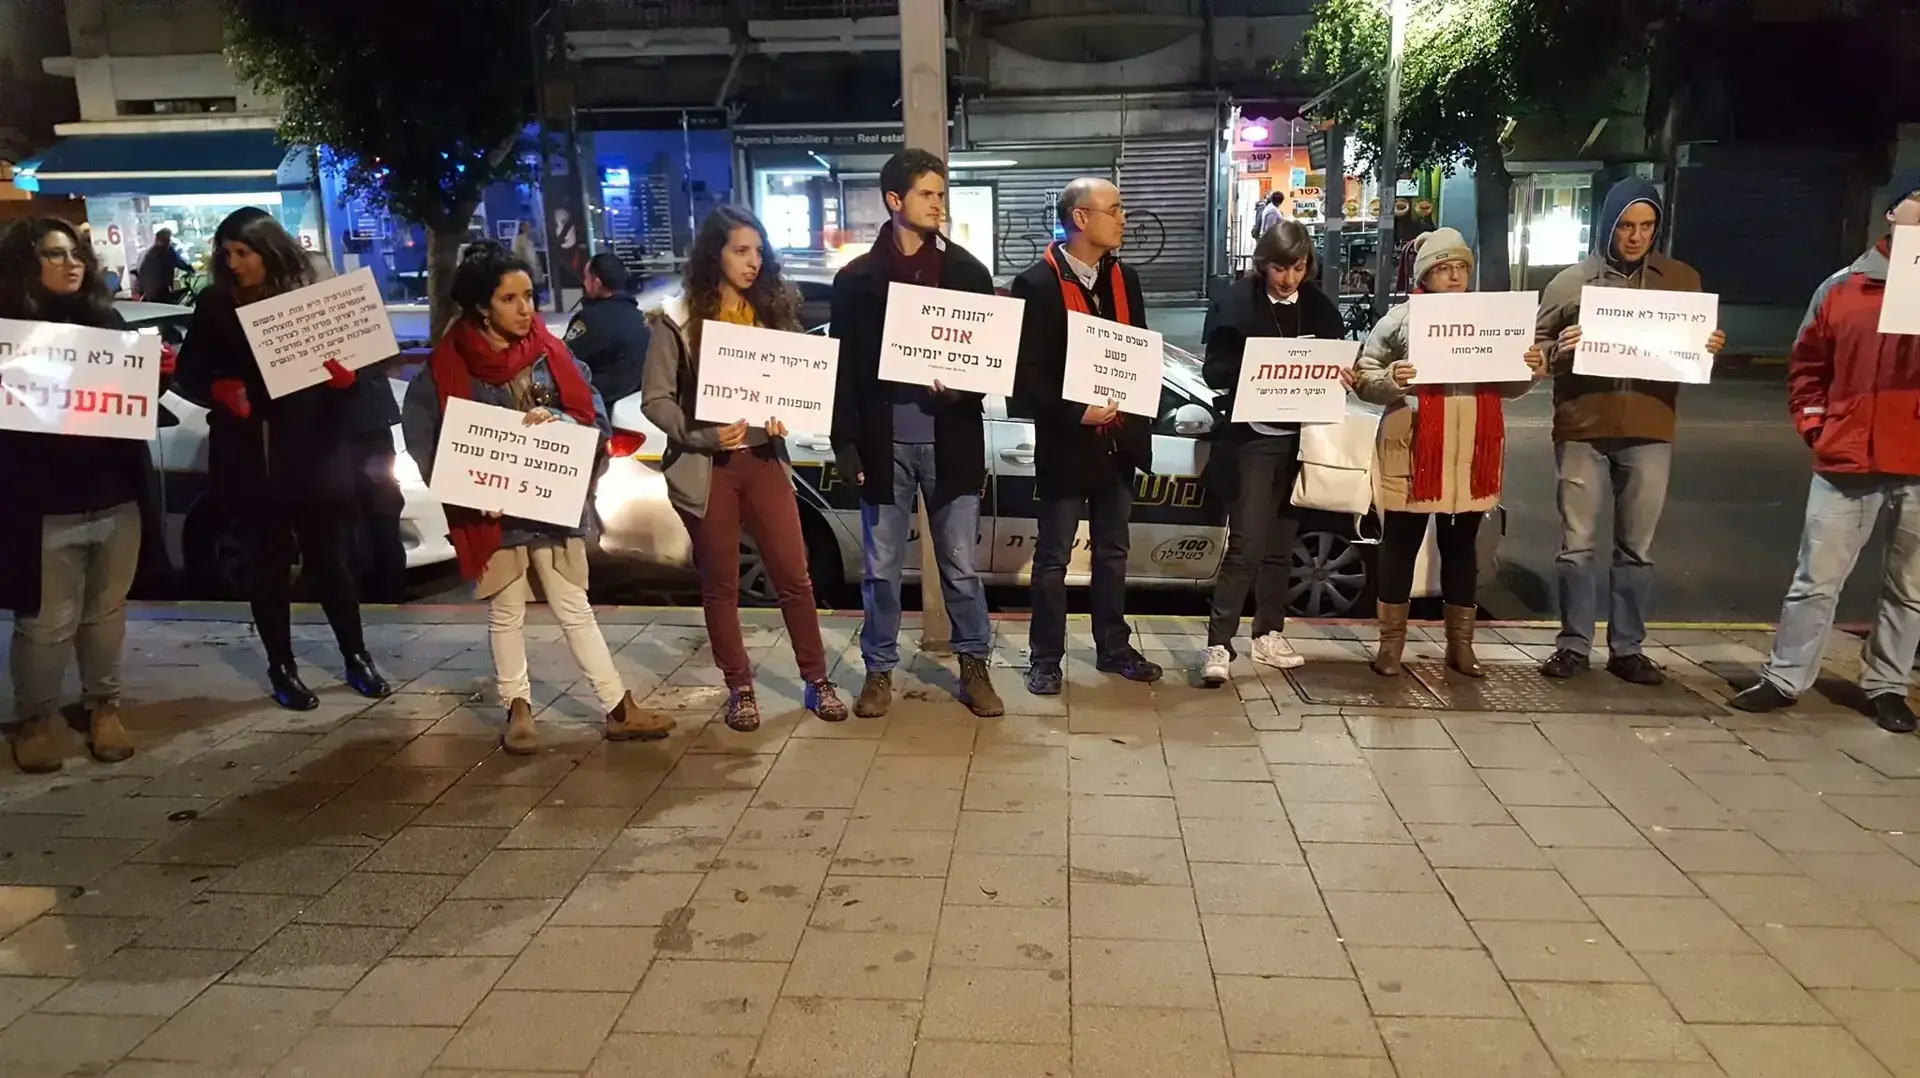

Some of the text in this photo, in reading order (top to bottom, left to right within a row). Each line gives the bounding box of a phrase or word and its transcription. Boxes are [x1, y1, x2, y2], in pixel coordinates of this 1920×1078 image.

[857, 133, 879, 143] Real
[881, 133, 905, 143] estat
[107, 224, 121, 245] 6
[921, 304, 946, 317] היא
[1596, 307, 1707, 323] לא ריקוד לא אומנות
[931, 325, 973, 344] אונס
[1086, 325, 1148, 348] לשלם על מין זה
[1427, 323, 1526, 337] נשים בזנות מתות
[305, 335, 316, 343] לא
[1104, 348, 1127, 362] פשע
[1581, 340, 1638, 356] אלימות
[87, 350, 114, 365] לא
[123, 354, 144, 369] זה
[270, 353, 296, 367] הנשים
[718, 346, 828, 370] לא ריקוד לא אומנות
[947, 351, 979, 366] בסיס
[986, 355, 1002, 369] על
[1093, 364, 1137, 381] תיגמלו כבר
[1250, 364, 1341, 382] מסוממת,
[703, 383, 760, 403] אלימות
[1093, 384, 1127, 400] מהרשע
[1290, 387, 1301, 395] לא
[1303, 388, 1326, 396] העיקר
[777, 396, 821, 410] חשפנות
[467, 424, 570, 455] מספר הלקוחות
[451, 440, 578, 477] הממוצע ביום עומד
[468, 469, 552, 499] על 5 וחצי
[1177, 540, 1209, 551] 100
[1159, 549, 1204, 561] בשבילך
